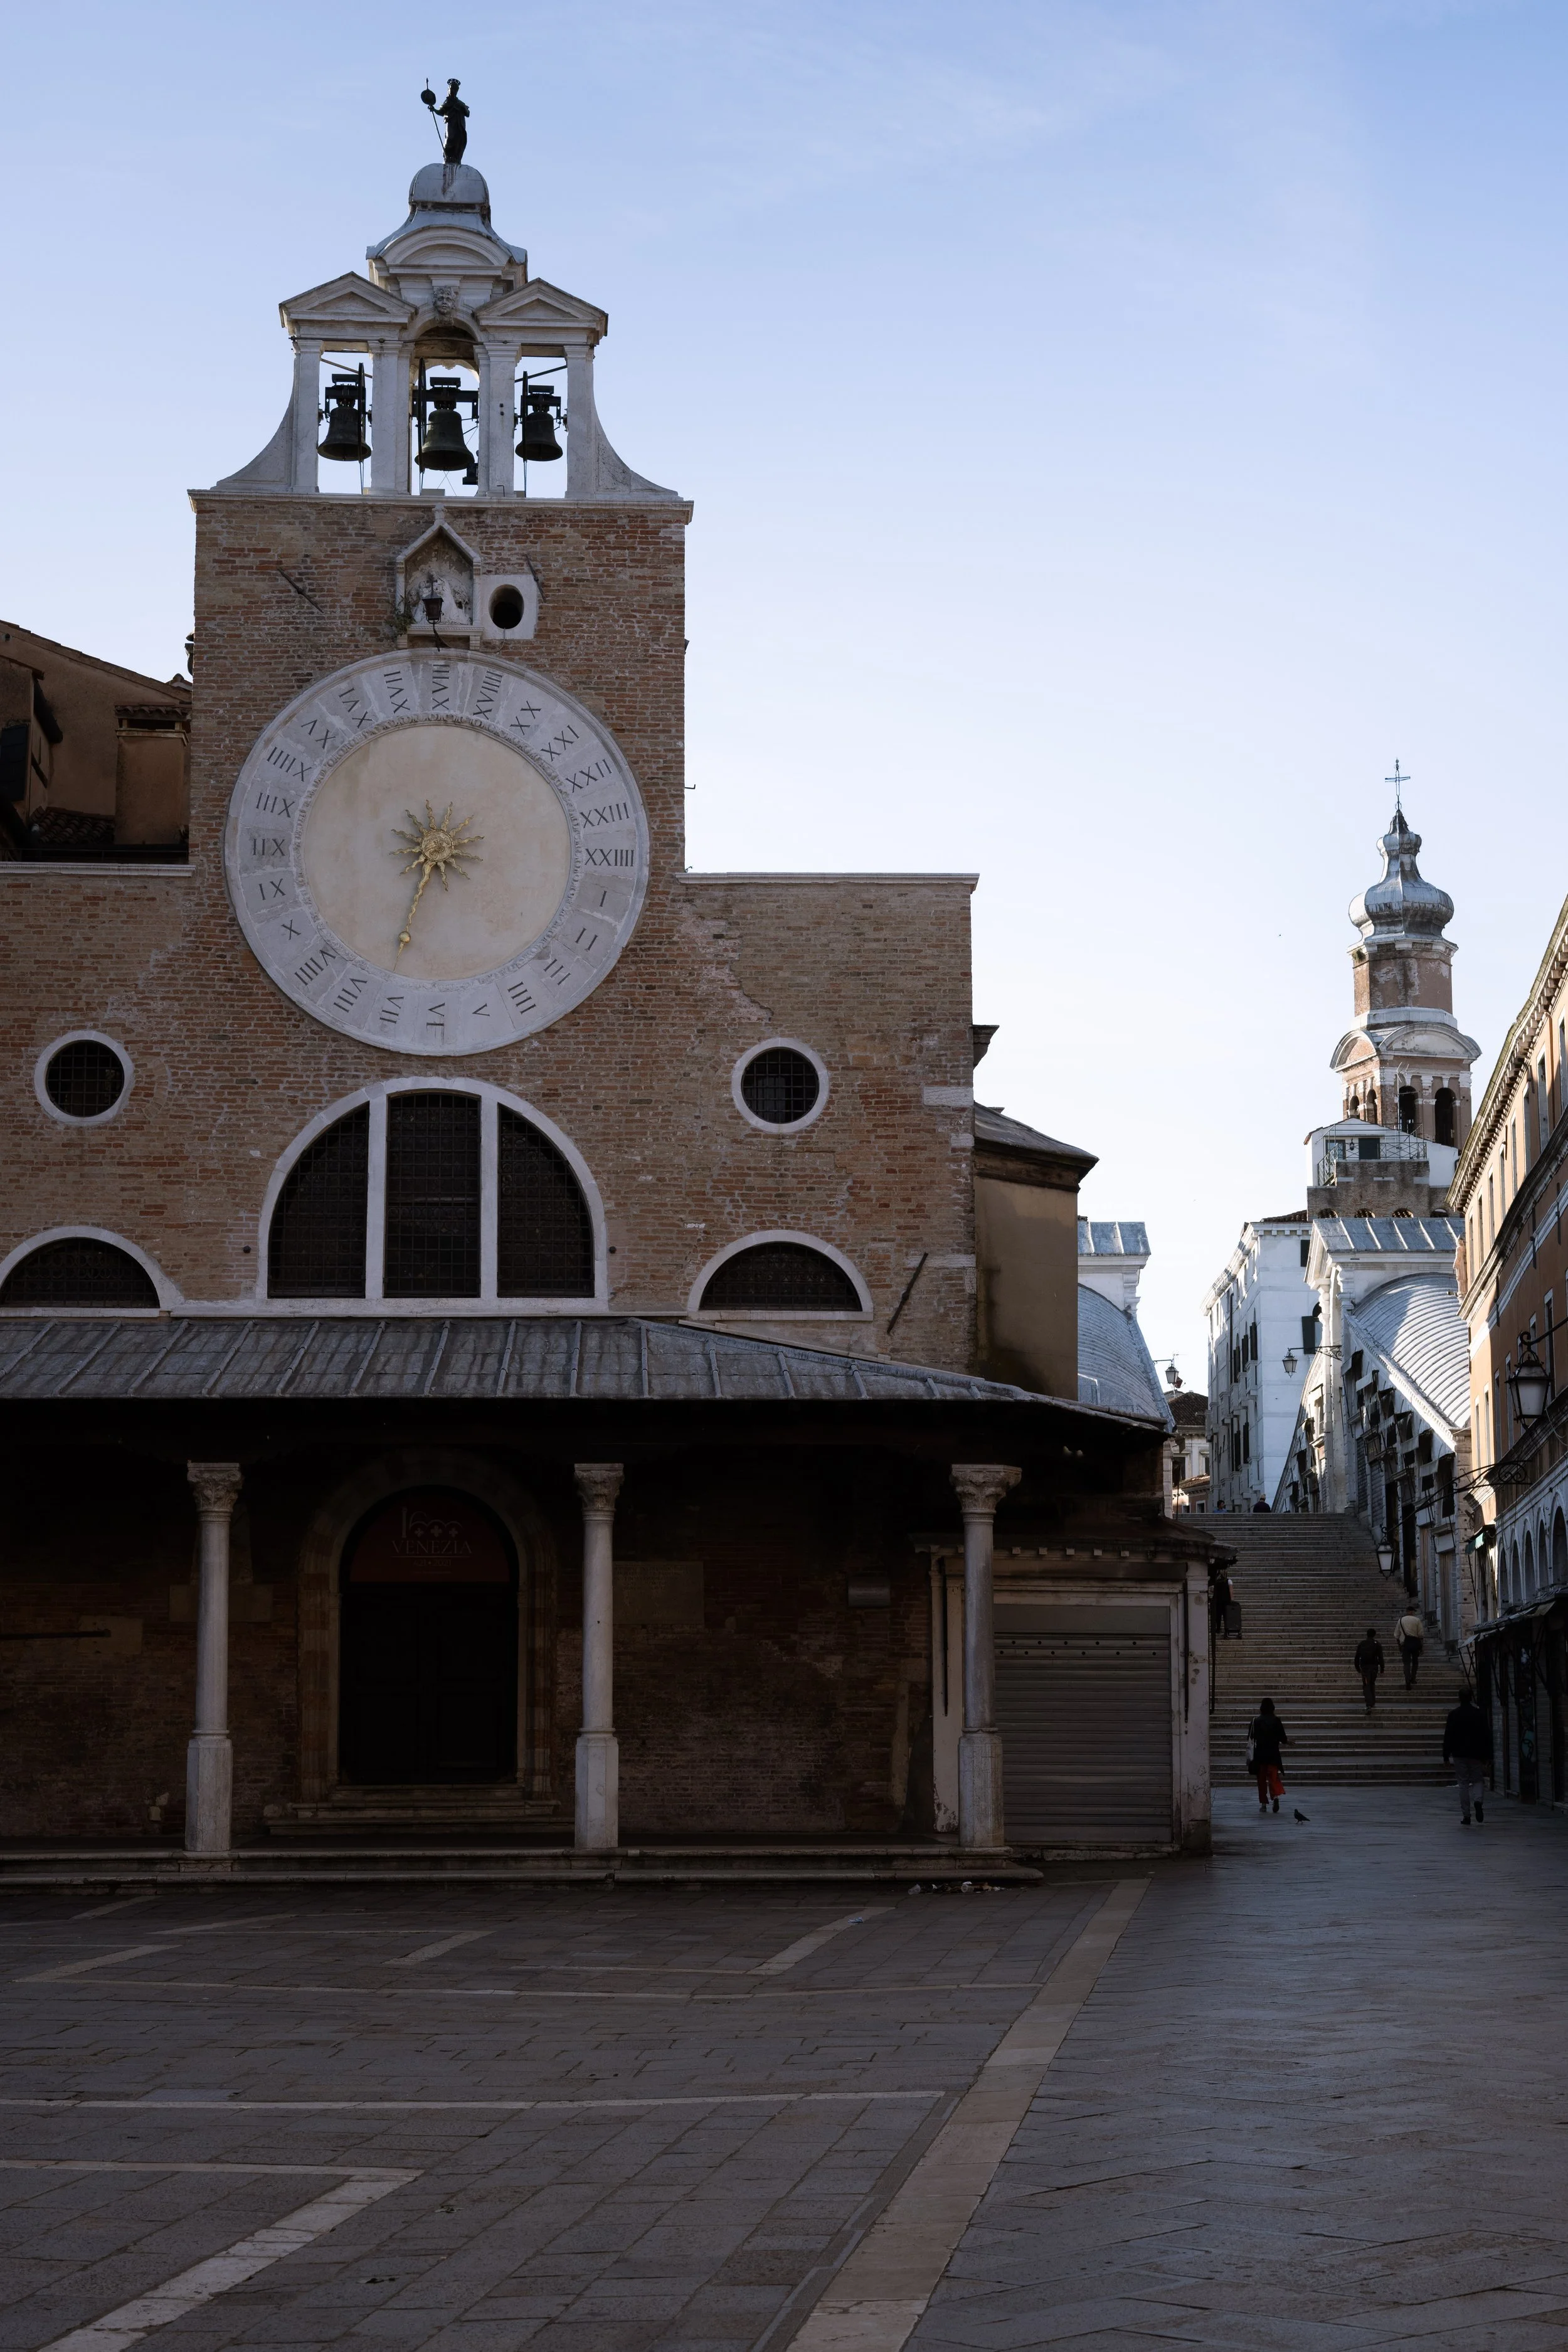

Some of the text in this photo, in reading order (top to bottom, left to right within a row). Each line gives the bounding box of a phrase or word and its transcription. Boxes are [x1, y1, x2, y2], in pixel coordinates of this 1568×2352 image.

[510, 701, 541, 735] XX
[541, 725, 580, 761] XXI
[565, 759, 612, 793] XXII
[580, 803, 630, 828] XXIII
[585, 849, 635, 867] XXIIII
[281, 919, 301, 940] X
[575, 928, 598, 951] II
[543, 958, 571, 985] III
[391, 1540, 473, 1554] VENEZIA
